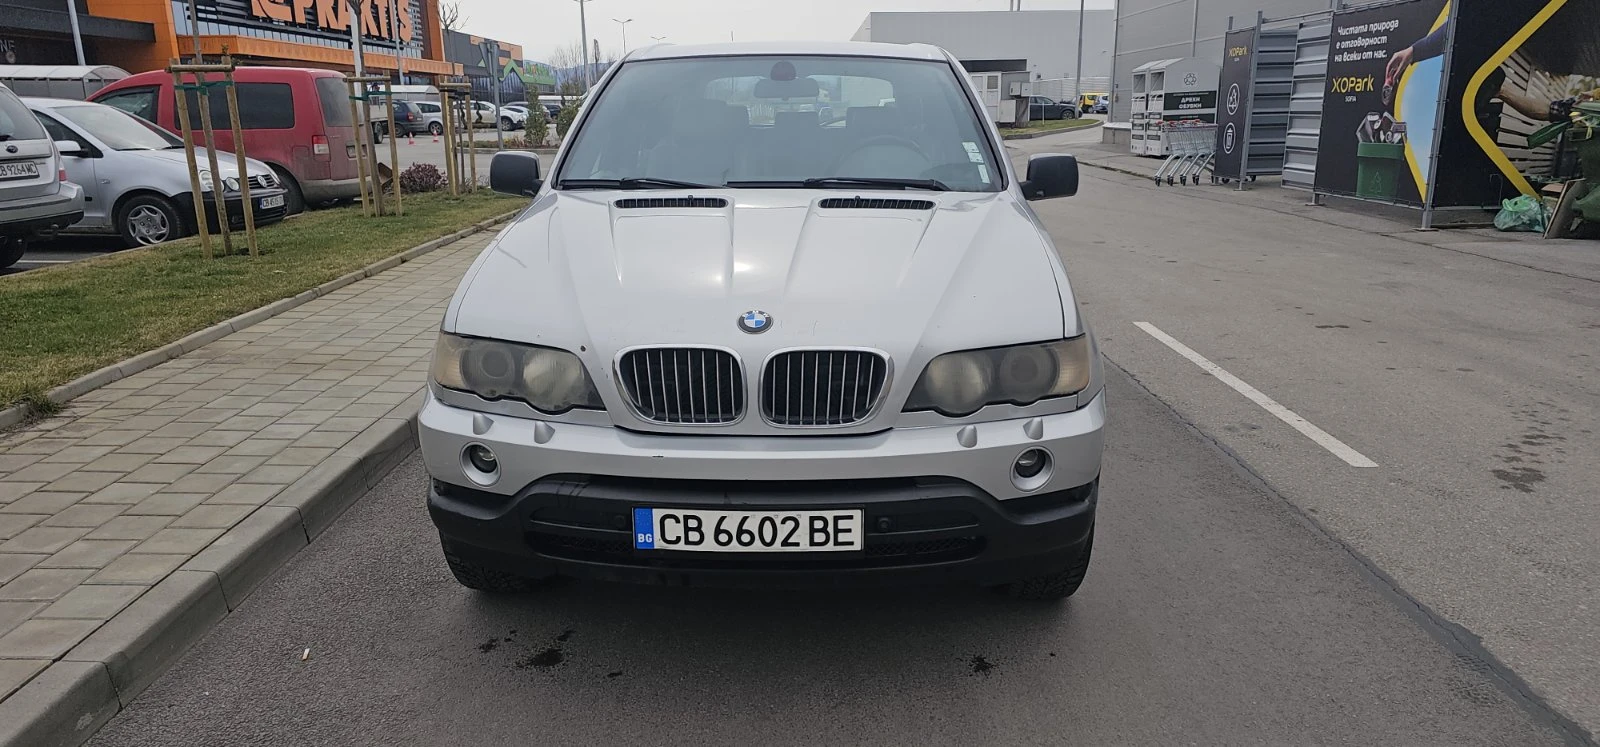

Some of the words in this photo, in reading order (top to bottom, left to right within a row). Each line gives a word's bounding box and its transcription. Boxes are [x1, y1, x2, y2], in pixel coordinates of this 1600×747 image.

[1337, 24, 1368, 36] Чистата
[1368, 19, 1399, 34] природа
[1336, 41, 1340, 49] е
[1340, 35, 1388, 49] отговорност
[1334, 54, 1342, 62] на
[1342, 51, 1362, 62] всеки
[1362, 51, 1373, 60] от
[659, 514, 705, 546] CB
[713, 515, 801, 547] 6602
[808, 515, 855, 547] BE
[637, 533, 653, 543] BG
